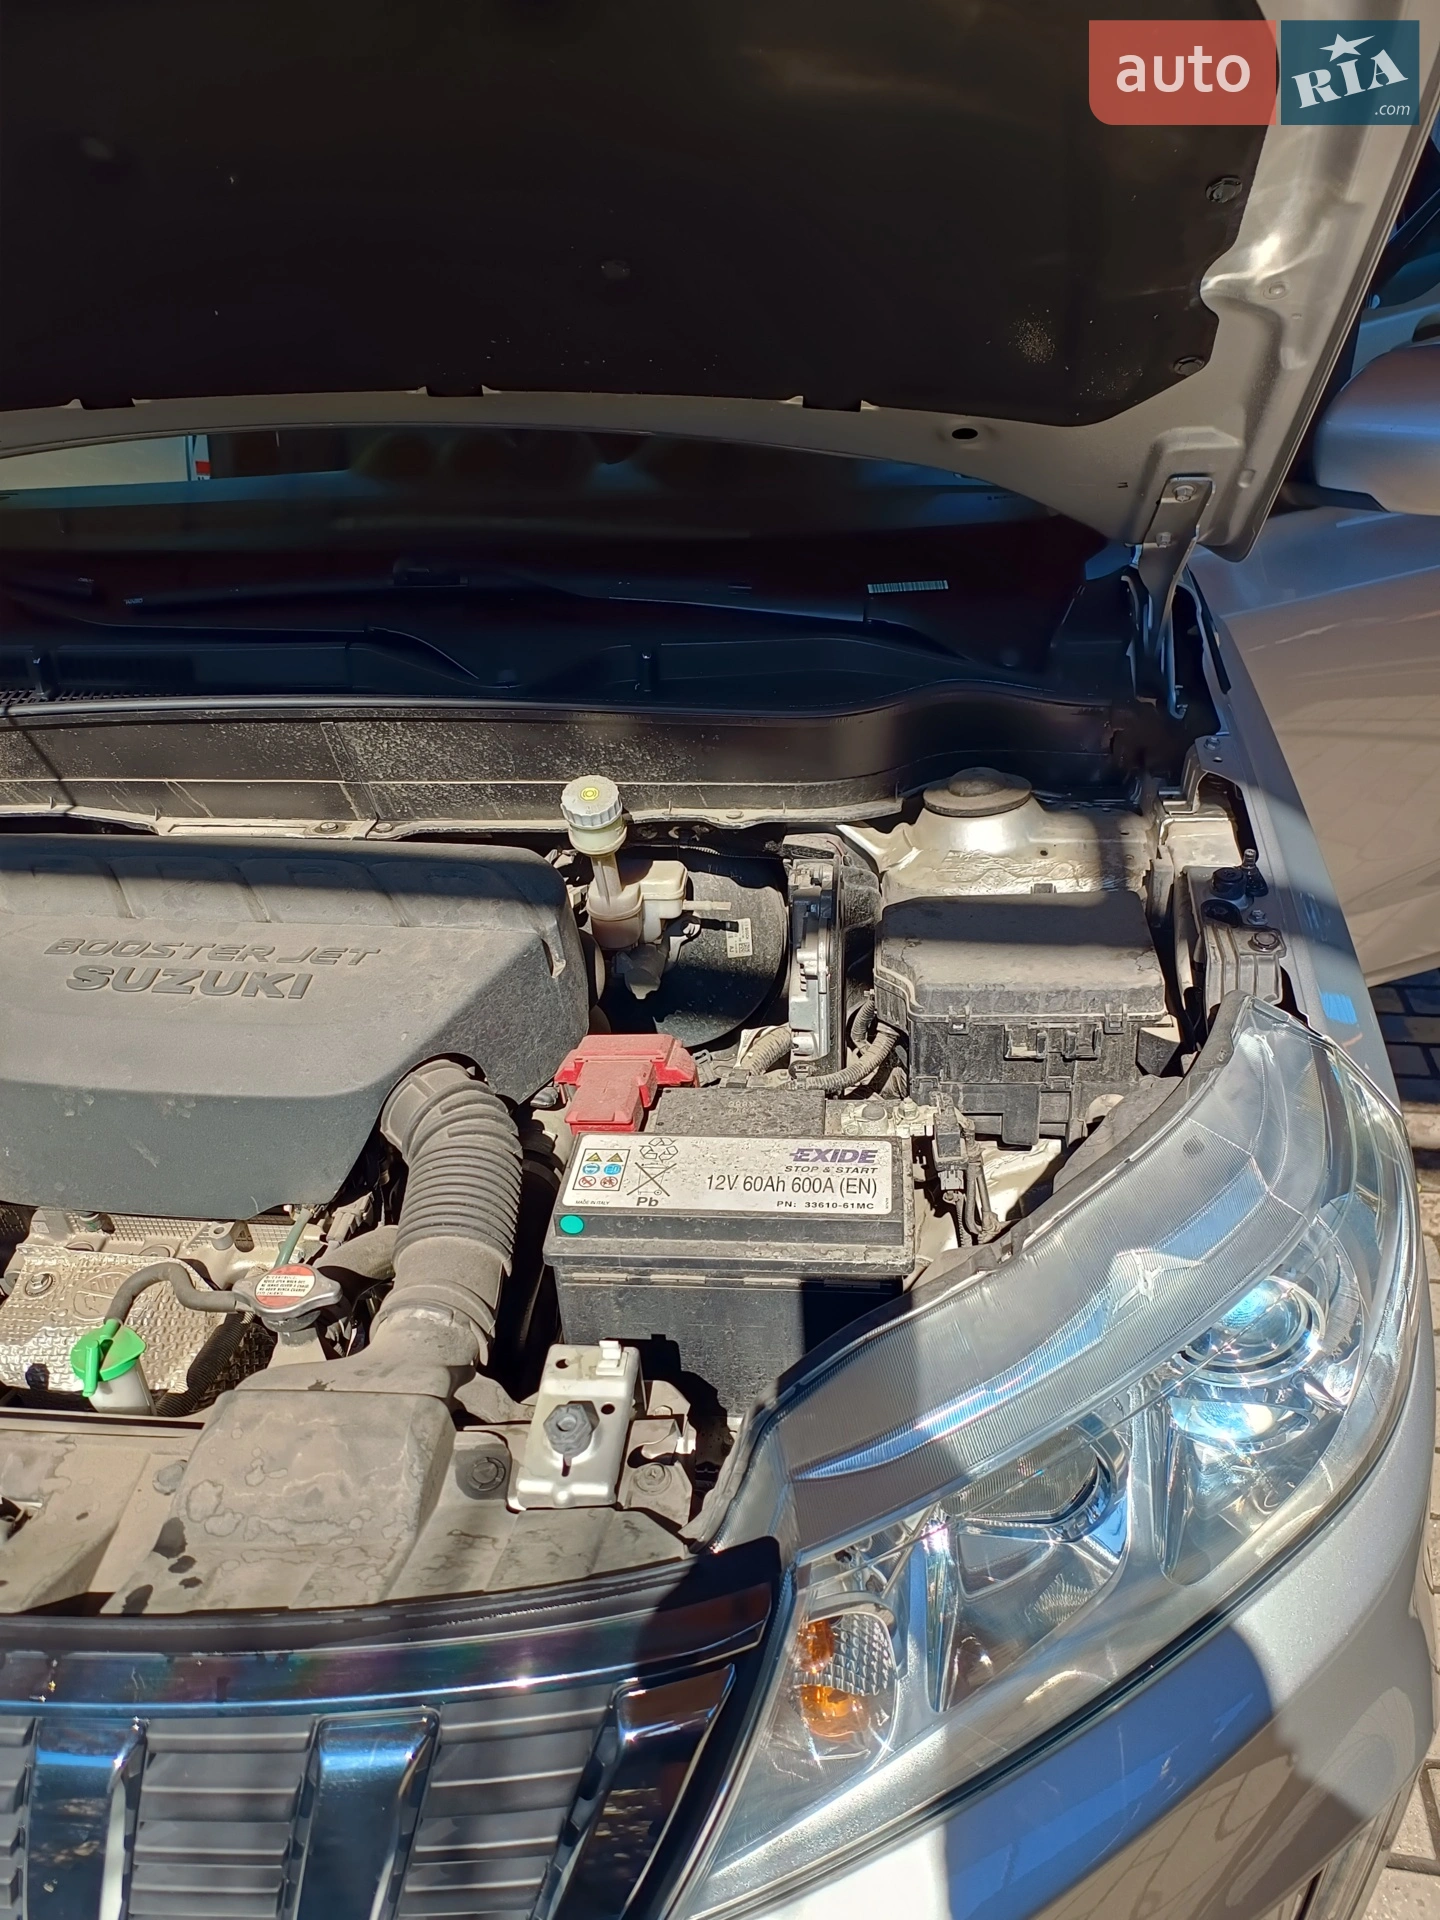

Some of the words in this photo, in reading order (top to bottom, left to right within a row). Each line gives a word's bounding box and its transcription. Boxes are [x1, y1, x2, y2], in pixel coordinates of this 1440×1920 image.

[66, 964, 314, 1000] SUZUKI
[789, 1147, 879, 1164] EXIDE
[784, 1165, 819, 1174] STOP
[822, 1166, 831, 1174] &
[835, 1166, 879, 1175] START
[707, 1174, 739, 1191] 12V
[743, 1174, 786, 1193] 60Ah
[791, 1176, 835, 1194] 600A
[839, 1176, 877, 1198] (EN)
[636, 1196, 660, 1207] Pb
[776, 1200, 797, 1209] PN:
[804, 1201, 875, 1210] 33610-61MC
